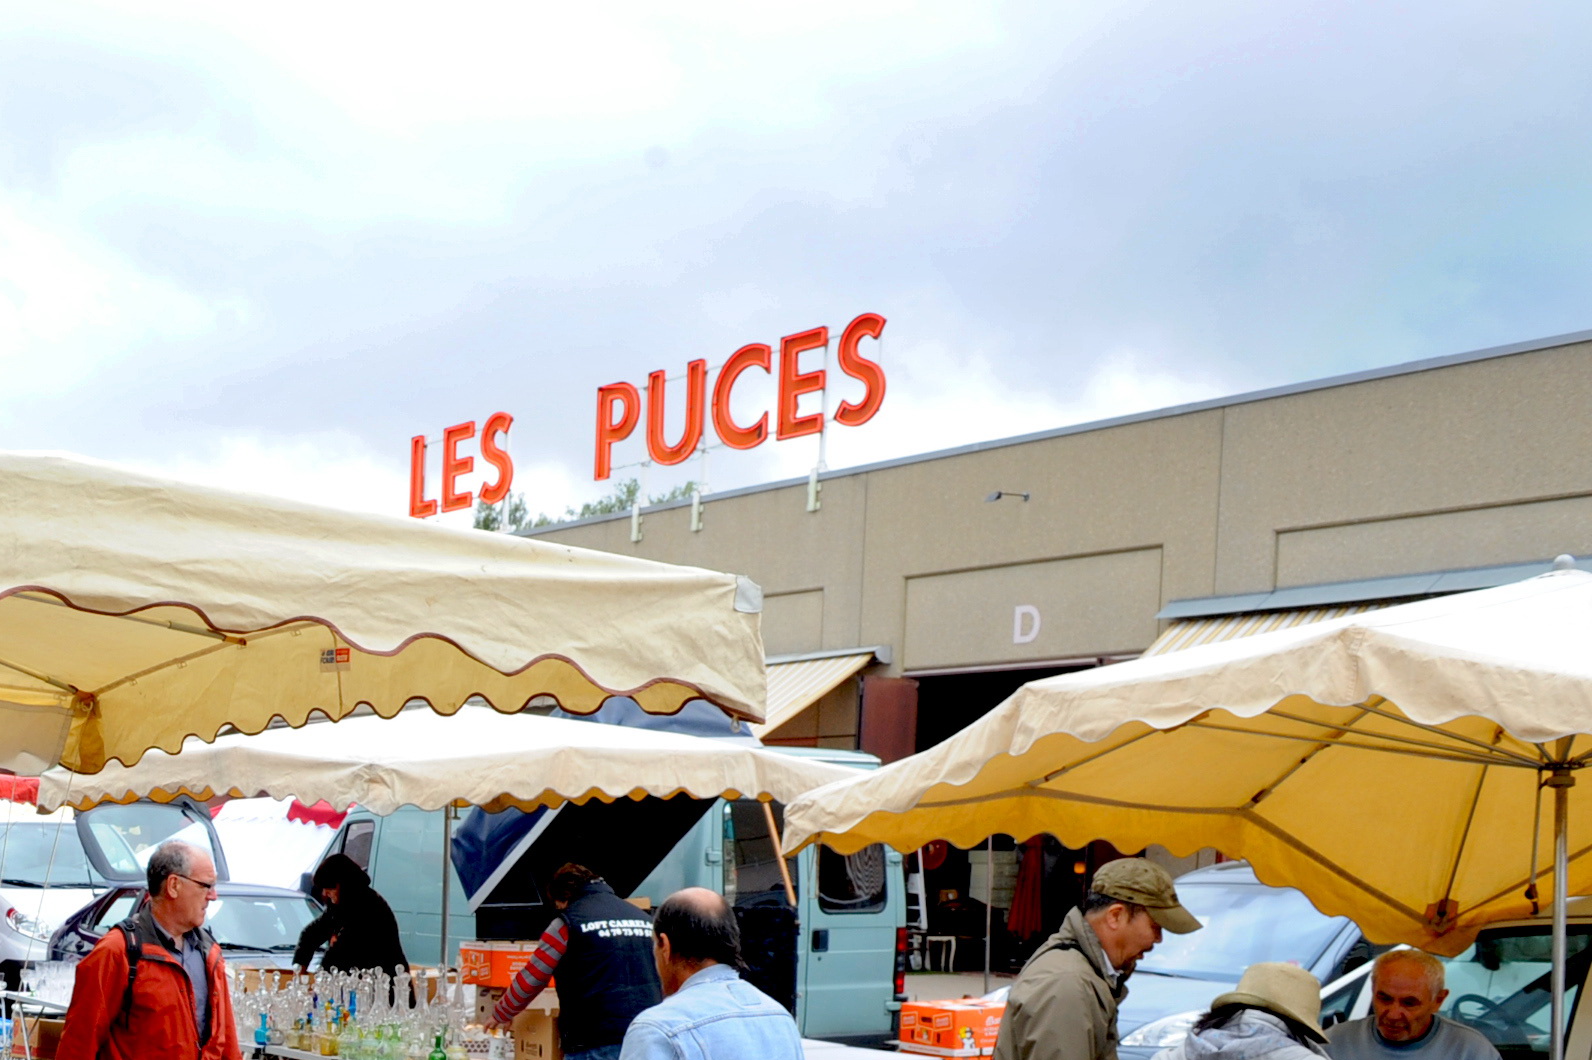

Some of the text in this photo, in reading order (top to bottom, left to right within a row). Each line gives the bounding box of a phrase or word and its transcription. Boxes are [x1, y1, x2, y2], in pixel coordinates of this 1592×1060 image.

[409, 312, 887, 519] LES PUCES
[1013, 604, 1042, 645] D
[580, 920, 608, 933] LOFT
